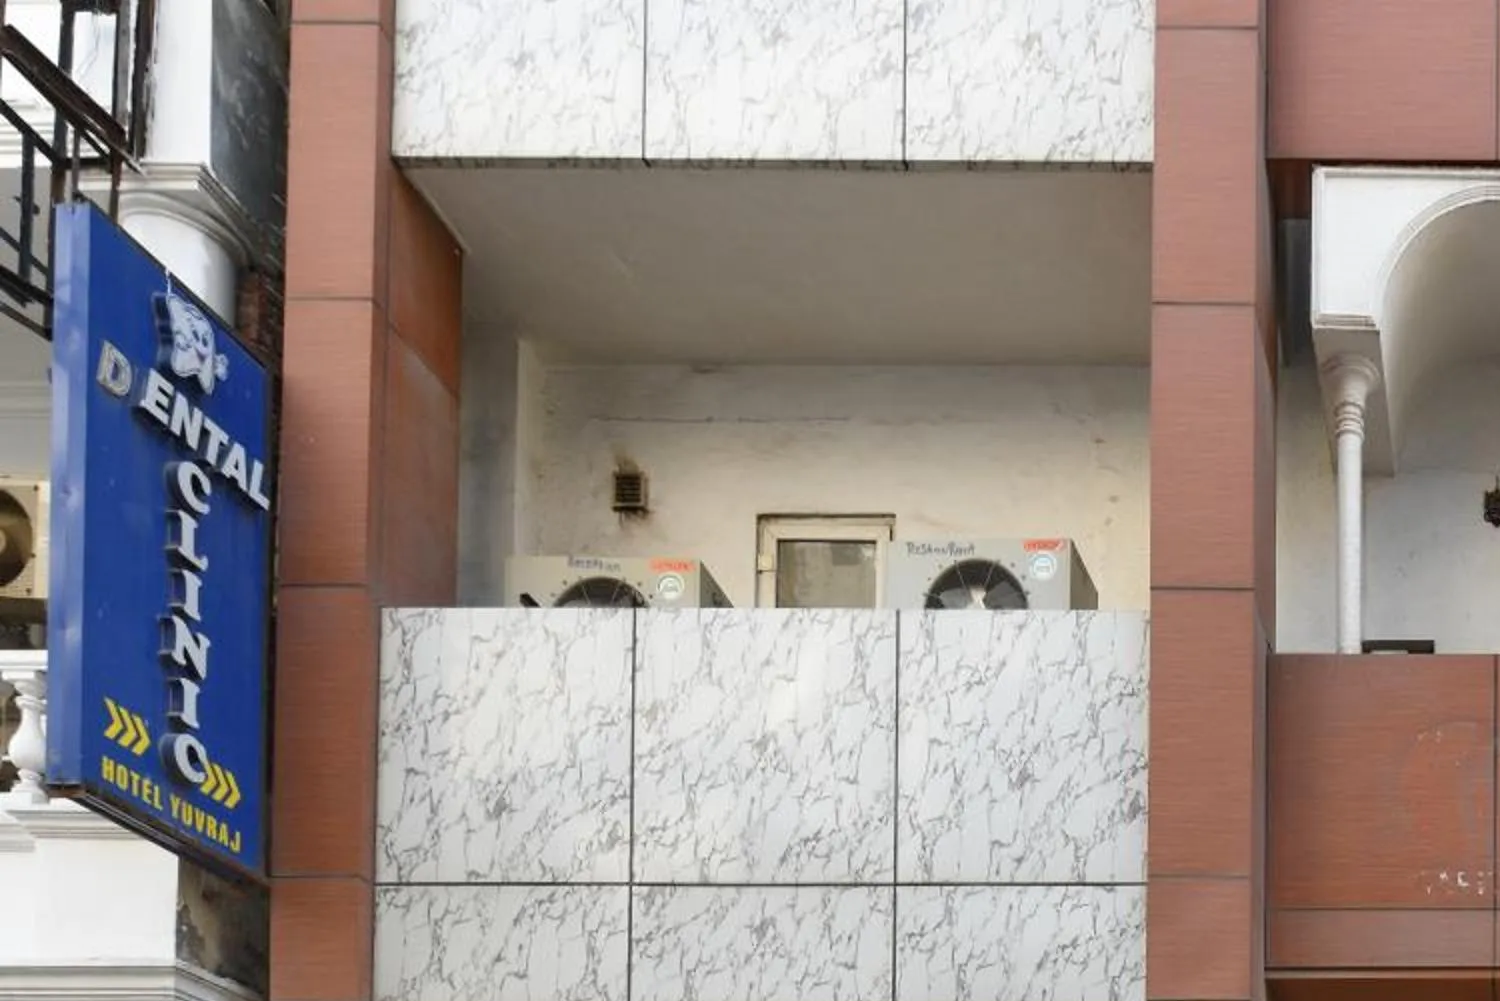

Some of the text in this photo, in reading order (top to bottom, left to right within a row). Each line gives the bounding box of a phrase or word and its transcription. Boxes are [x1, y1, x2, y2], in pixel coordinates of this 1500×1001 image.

[97, 338, 271, 511] DENTAL
[162, 460, 212, 784] CLINIC
[101, 754, 243, 853] HOTEL YUVRAJ
